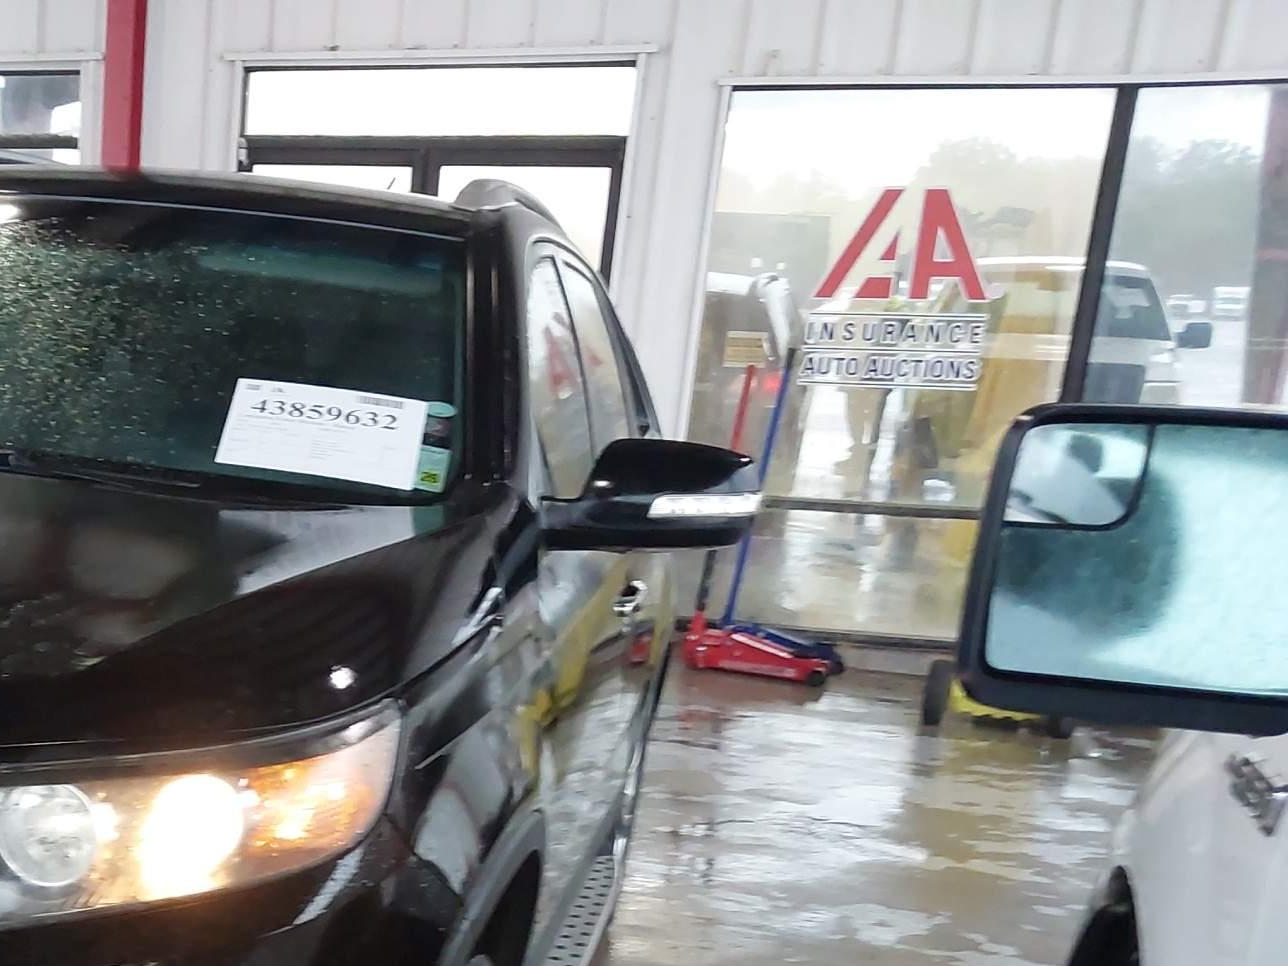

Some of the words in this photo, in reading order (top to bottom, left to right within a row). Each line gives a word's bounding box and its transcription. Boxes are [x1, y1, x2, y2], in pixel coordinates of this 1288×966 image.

[804, 320, 985, 345] INSURANCE
[800, 355, 858, 376] AUTO
[863, 356, 979, 380] AUCTIONS
[250, 398, 399, 431] 43859632
